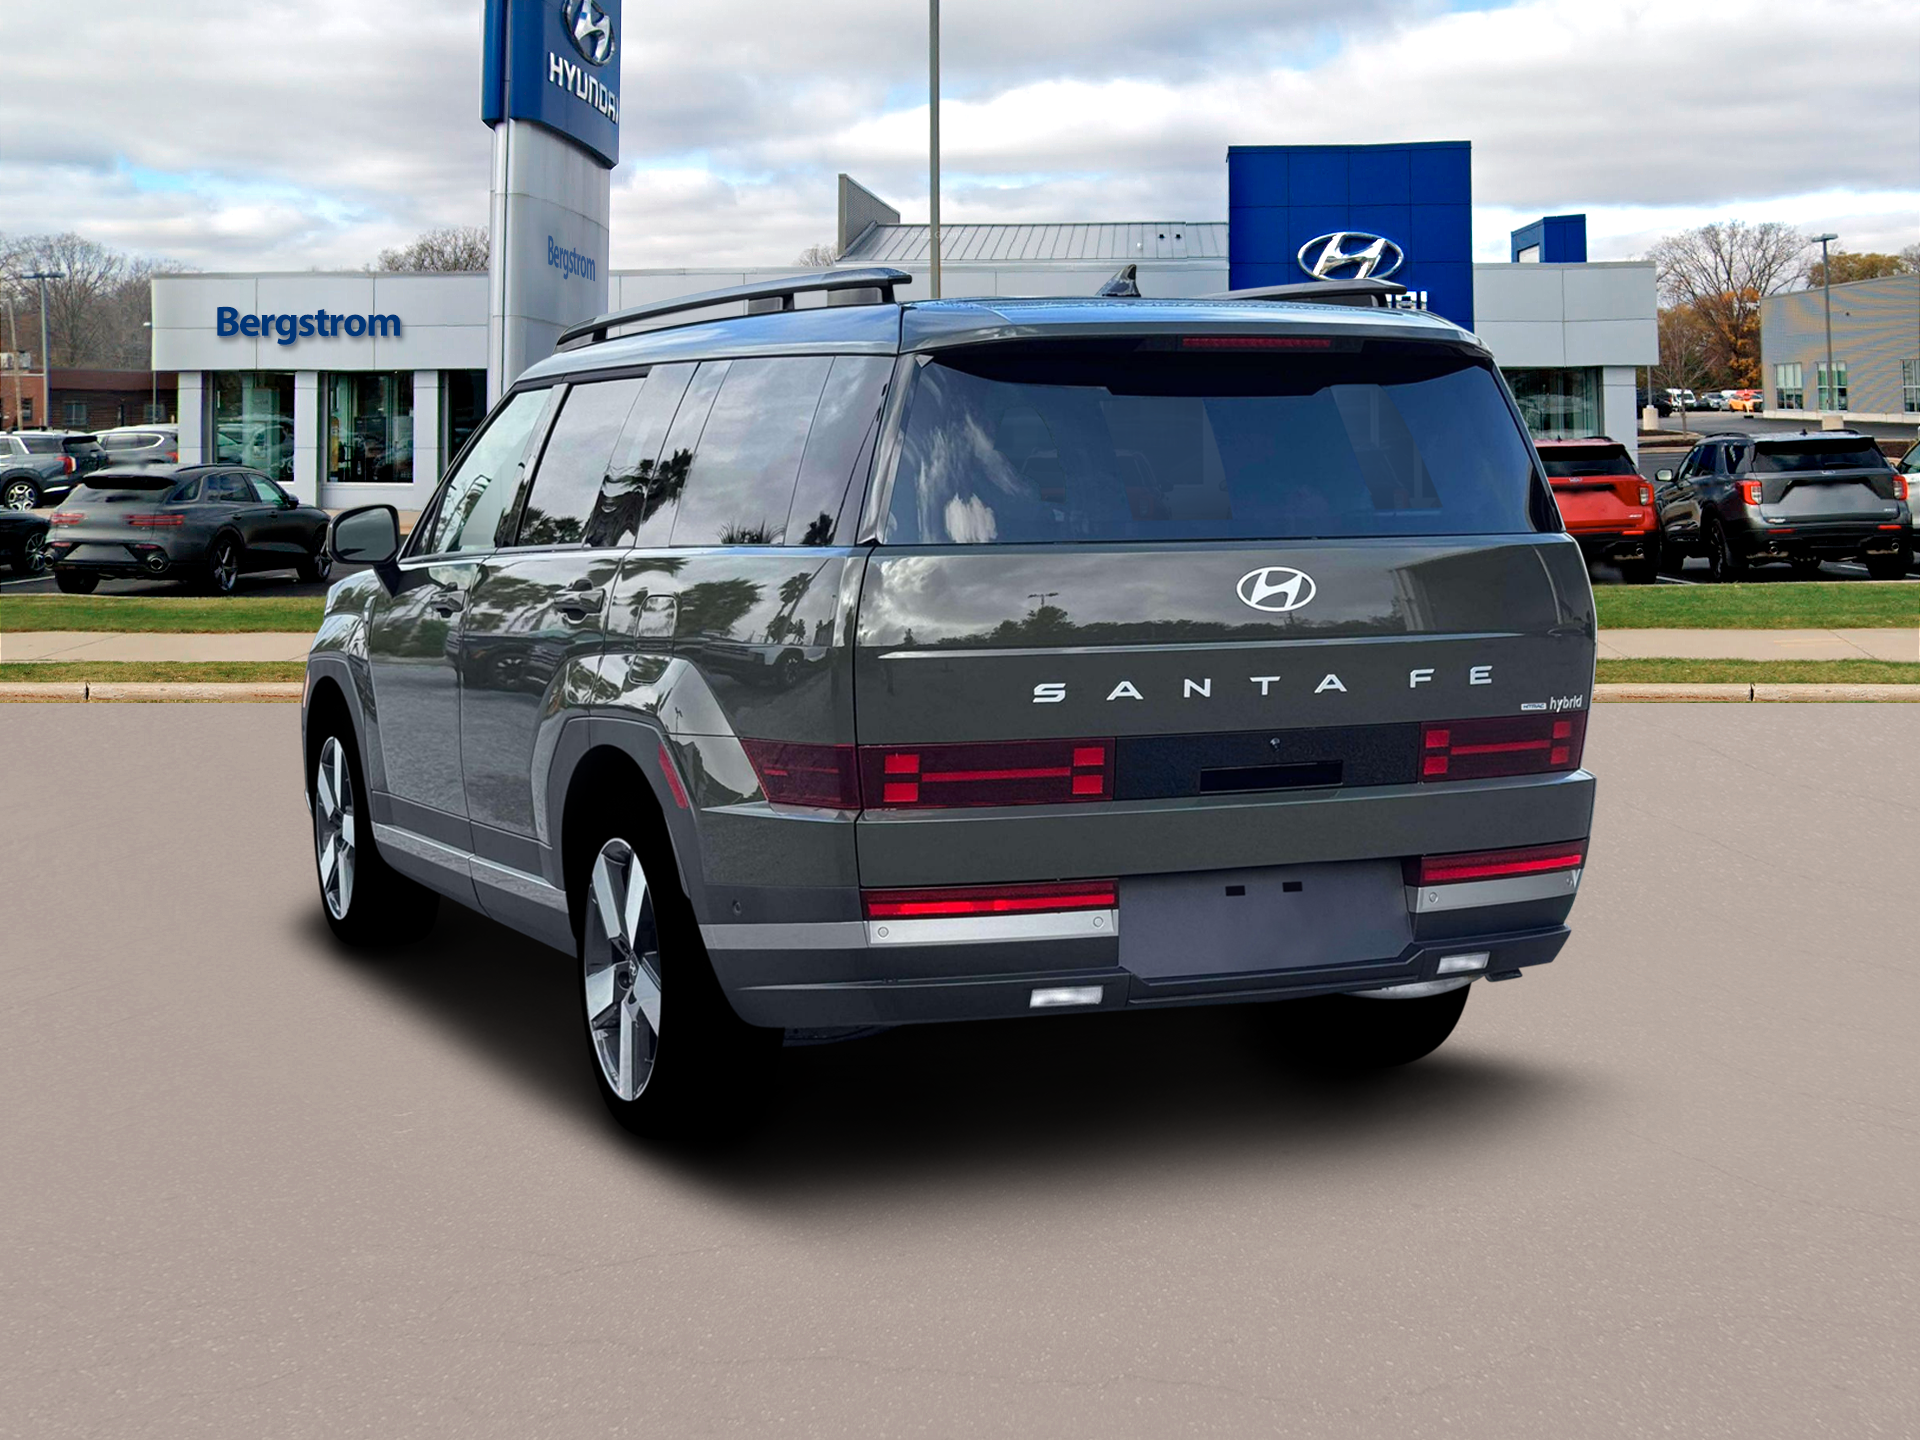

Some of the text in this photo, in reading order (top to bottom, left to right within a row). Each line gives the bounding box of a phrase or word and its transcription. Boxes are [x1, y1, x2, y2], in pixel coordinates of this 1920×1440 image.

[548, 51, 619, 125] HYUNDAI
[547, 235, 596, 282] Bergstrom
[216, 306, 402, 346] Bergstrom
[1033, 664, 1494, 703] SANTA FE
[1549, 694, 1583, 713] hybrid
